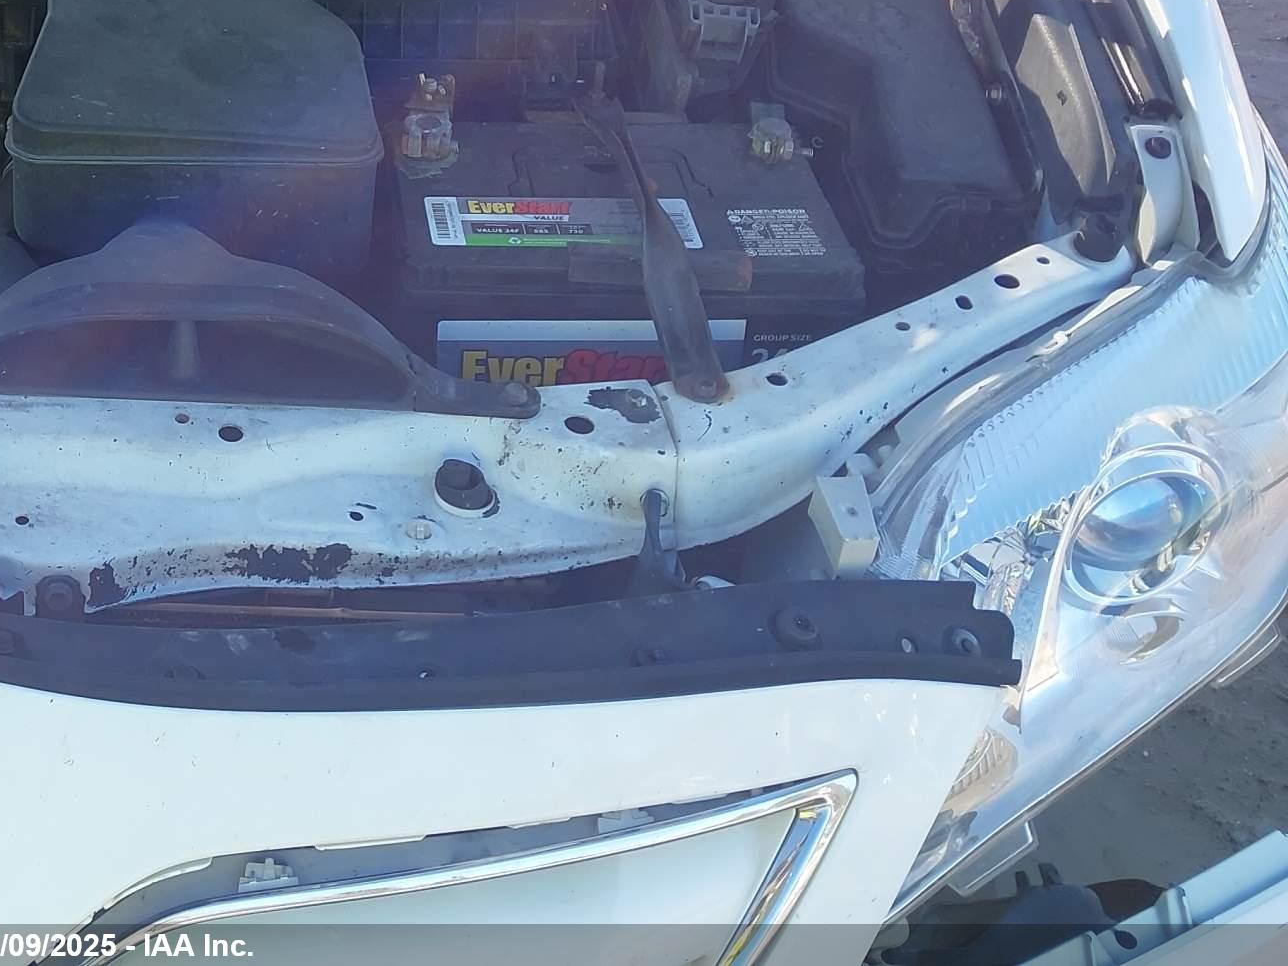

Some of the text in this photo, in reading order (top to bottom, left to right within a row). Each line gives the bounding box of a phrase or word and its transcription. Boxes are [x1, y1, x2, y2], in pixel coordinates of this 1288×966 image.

[467, 200, 571, 214] EverStart
[753, 334, 812, 342] GROUP SIZE
[461, 349, 668, 385] EverStar
